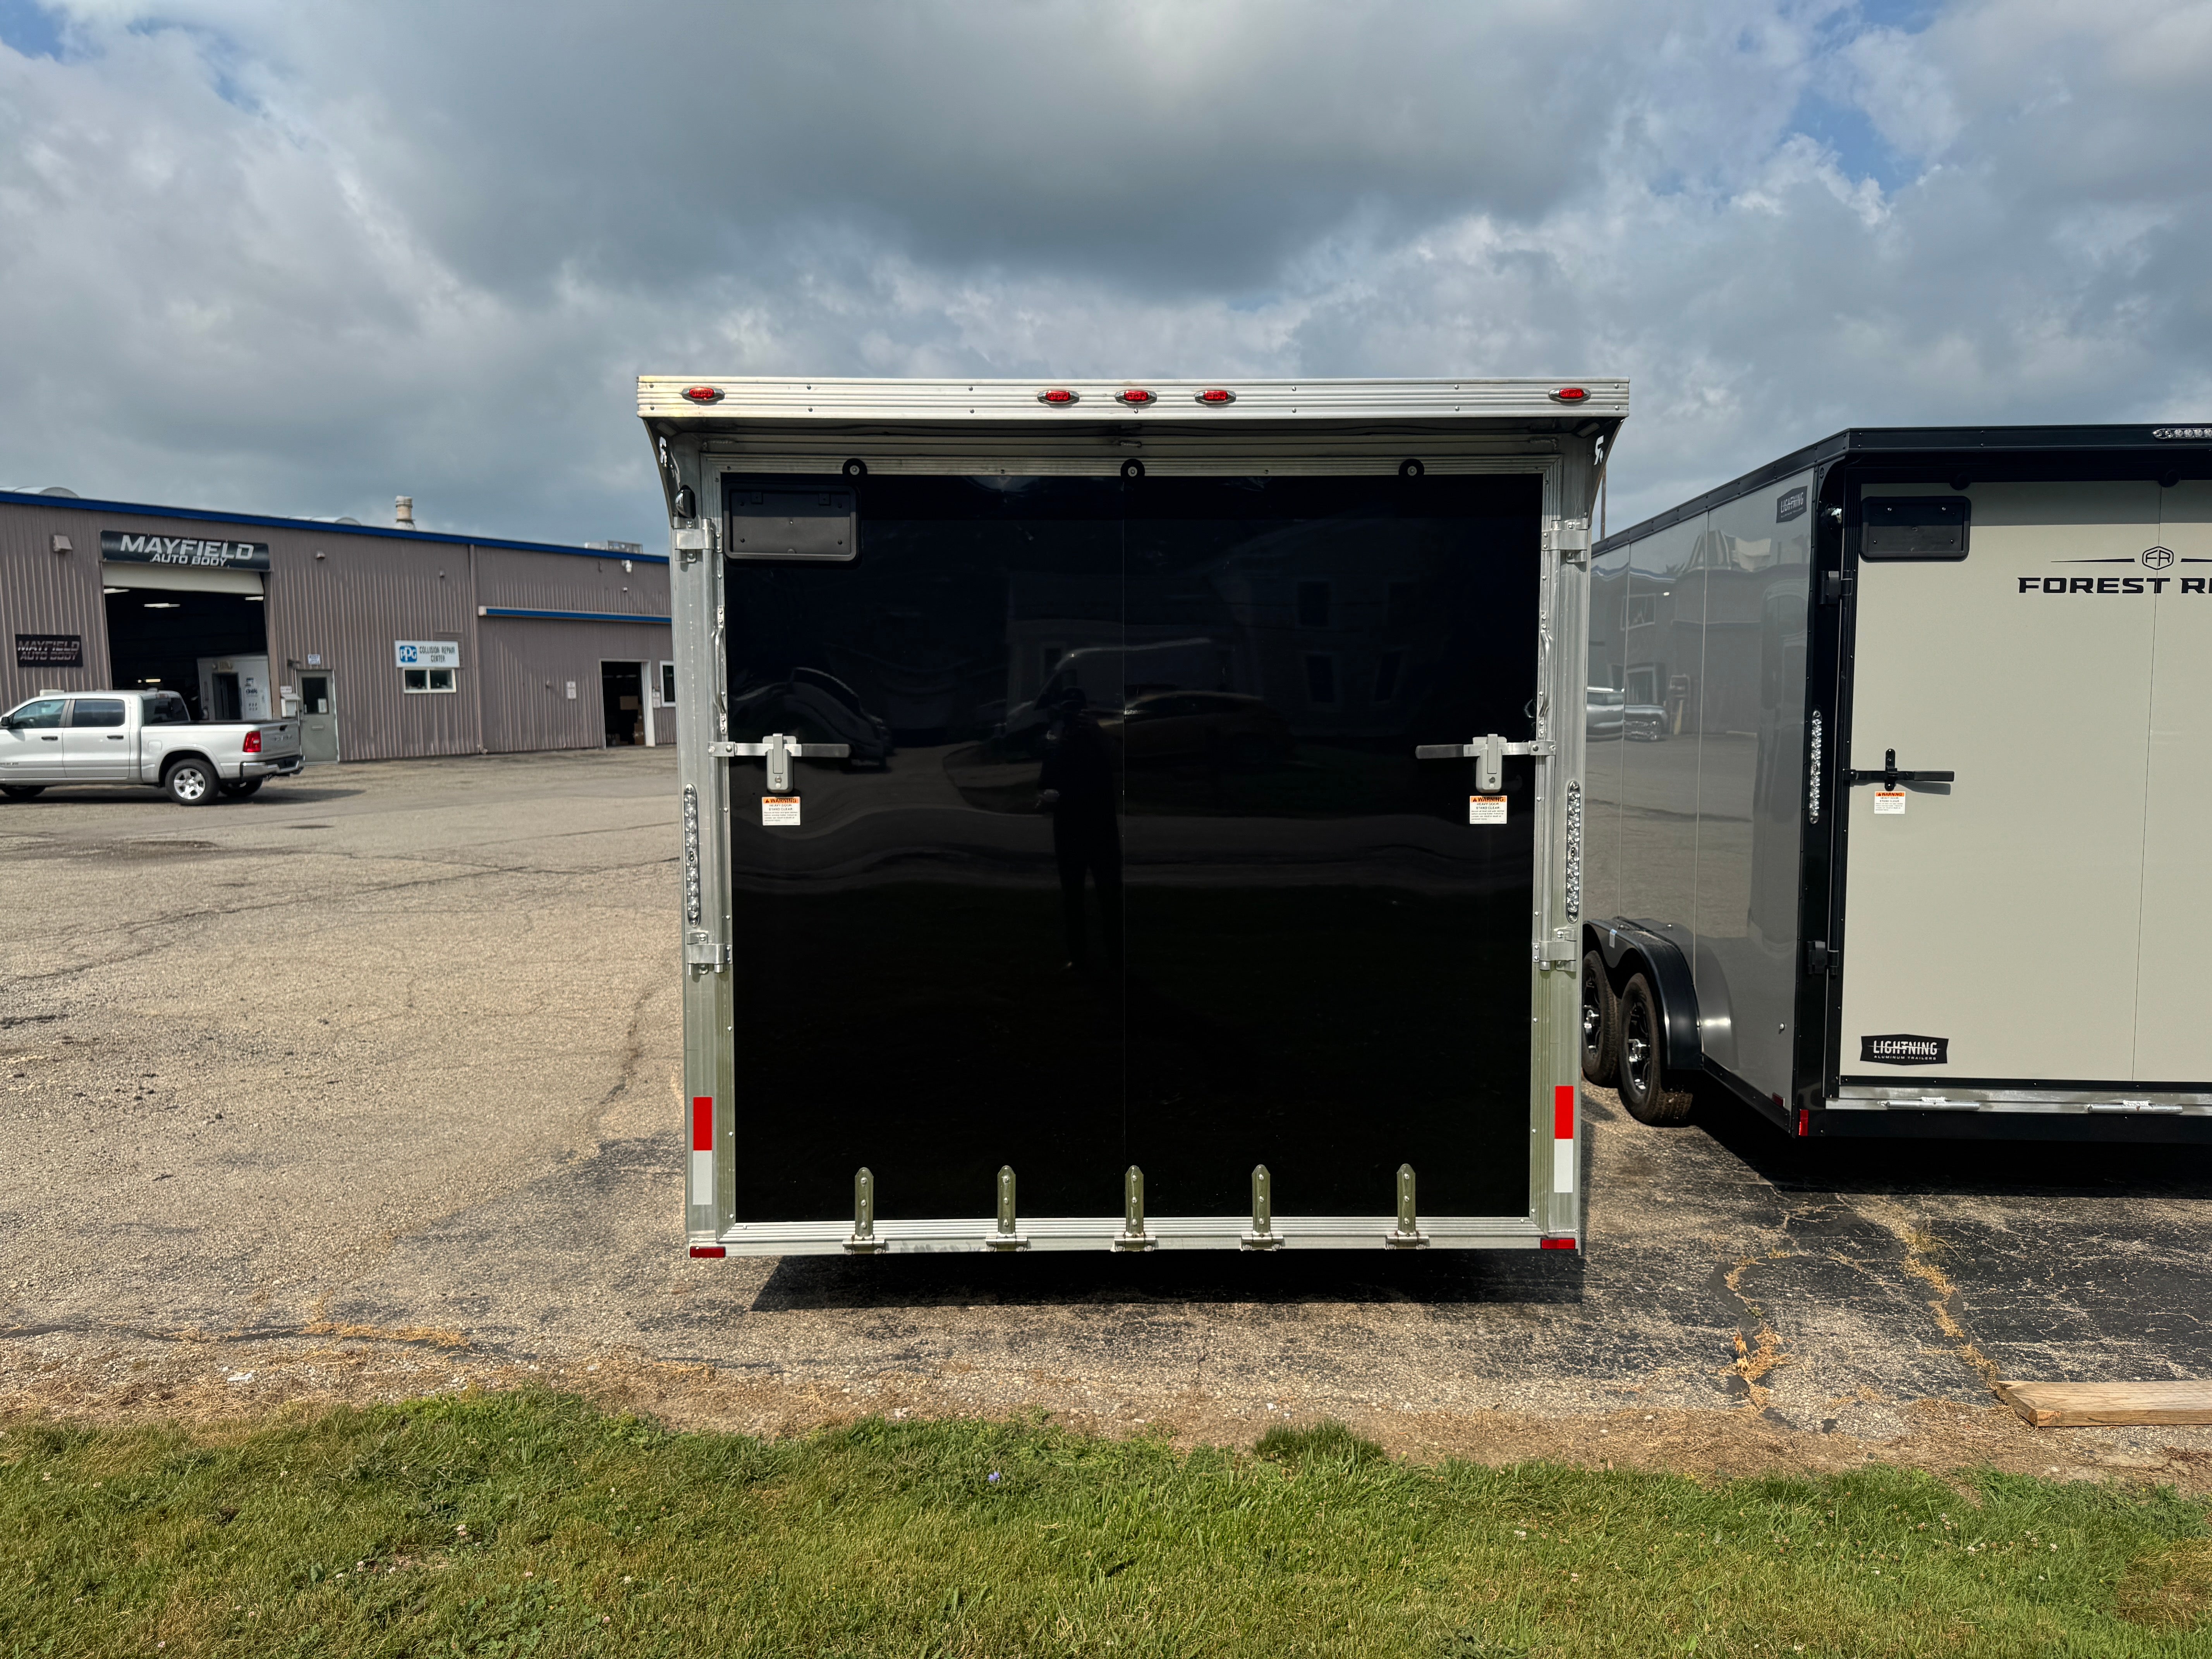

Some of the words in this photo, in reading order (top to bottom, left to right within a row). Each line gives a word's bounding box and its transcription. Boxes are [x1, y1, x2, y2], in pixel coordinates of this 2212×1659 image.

[1781, 492, 1803, 513] LIGHTNING
[120, 535, 254, 560] MAYFIELD
[152, 553, 187, 564] AUTO
[192, 555, 227, 567] BODY
[2017, 577, 2171, 594] FOREST
[18, 641, 80, 651] MAYFIELD
[420, 646, 440, 654] COLLISION
[20, 651, 47, 660] AUTO
[400, 647, 417, 661] PPG
[1873, 1041, 1937, 1055] LIGHTNING
